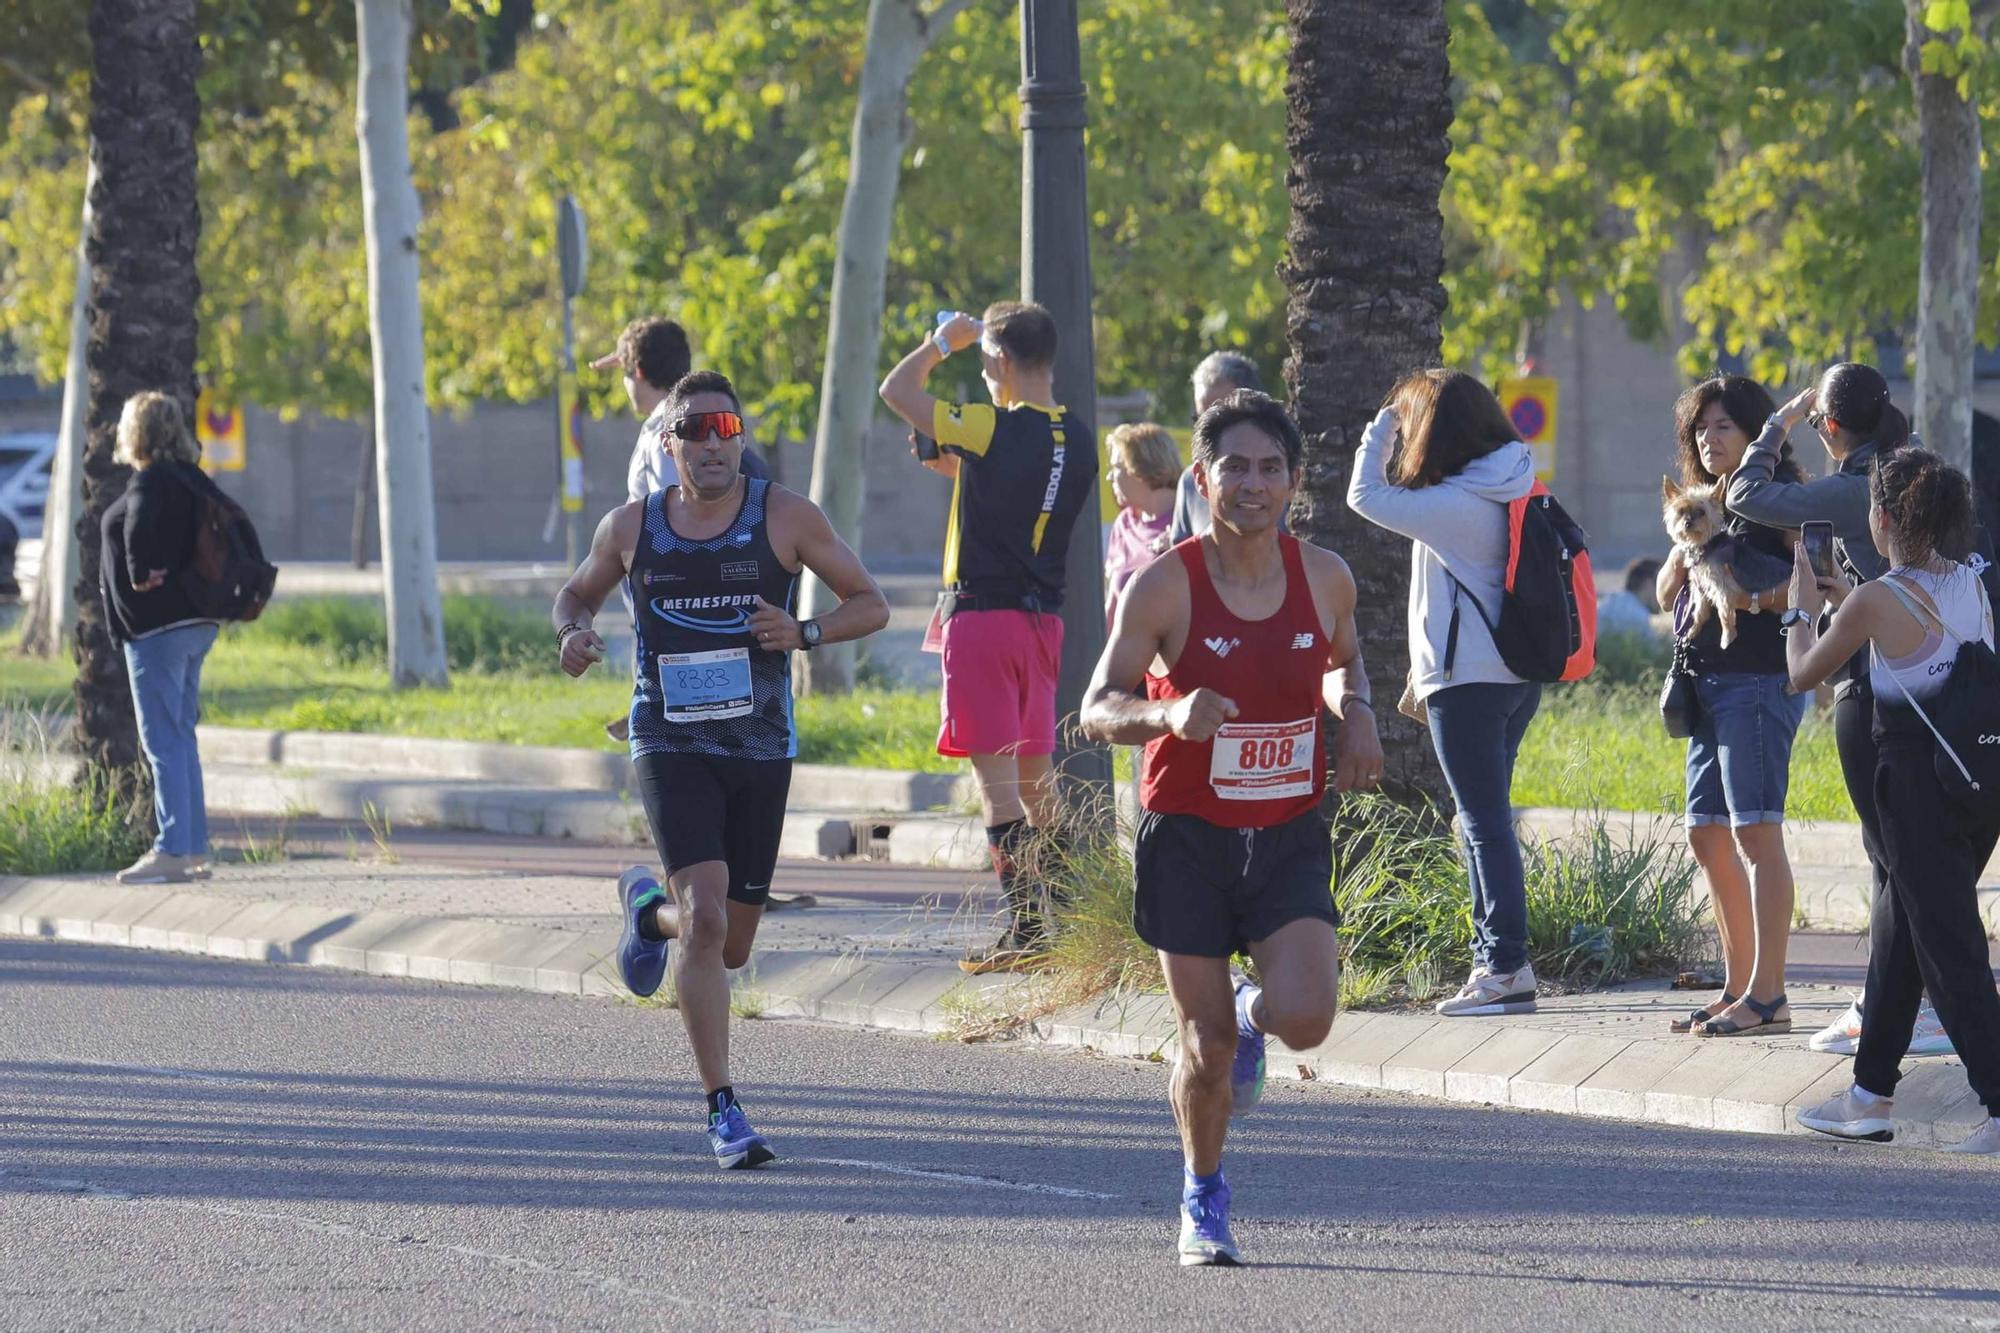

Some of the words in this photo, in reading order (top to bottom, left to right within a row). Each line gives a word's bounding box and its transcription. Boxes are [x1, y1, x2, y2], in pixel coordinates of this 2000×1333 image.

[1041, 447, 1065, 511] REDOLAT
[663, 595, 760, 610] METAESPORT
[676, 668, 730, 690] 8383
[1238, 737, 1295, 770] 808
